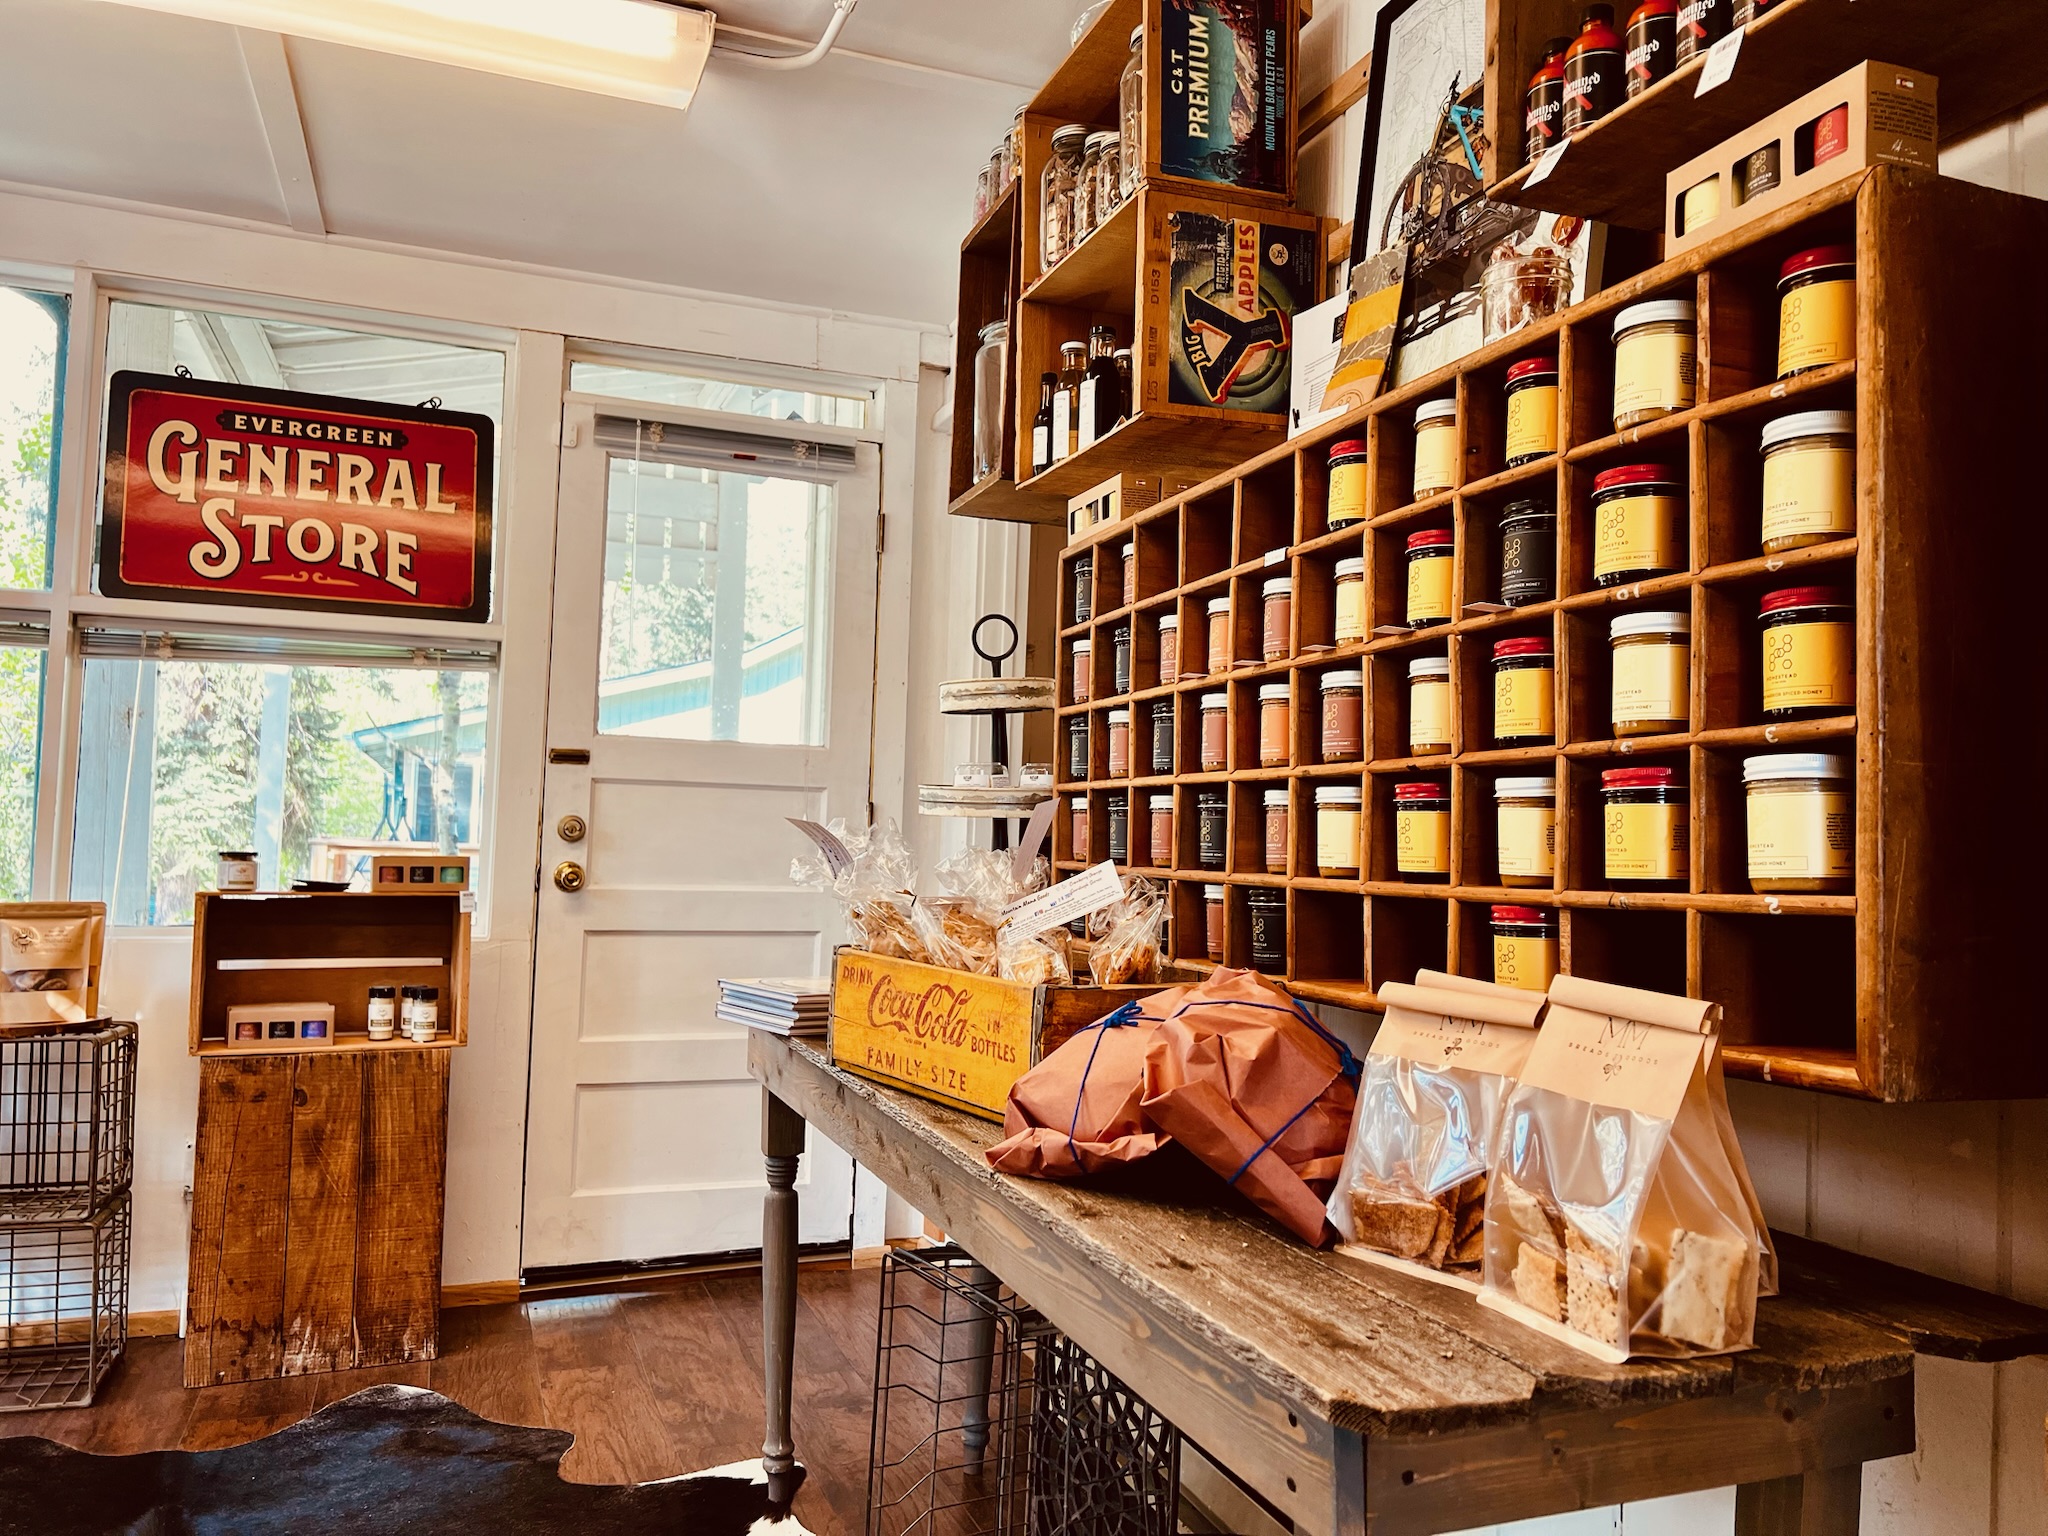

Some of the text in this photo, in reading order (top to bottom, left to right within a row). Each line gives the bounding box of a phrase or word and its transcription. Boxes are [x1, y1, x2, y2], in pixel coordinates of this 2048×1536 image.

[1171, 49, 1184, 95] C & T
[1188, 13, 1210, 140] PREMIUM
[1265, 29, 1276, 151] MOUNTAIN BARTLETT PEARS
[1276, 93, 1285, 118] PRODUCE
[1238, 223, 1255, 314] APPLES
[1150, 268, 1161, 305] D153
[1185, 334, 1207, 367] BIG
[234, 413, 394, 447] EVERGREEN
[147, 419, 457, 515] GENERAL
[188, 497, 418, 597] STORE
[1001, 904, 1021, 917] Mountain
[842, 966, 874, 988] DRINK
[971, 1035, 1017, 1064] BOTTLES
[1413, 1030, 1450, 1042] BREADS
[1568, 1042, 1609, 1058] BREADS
[867, 1046, 967, 1092] FAMILY SIZE
